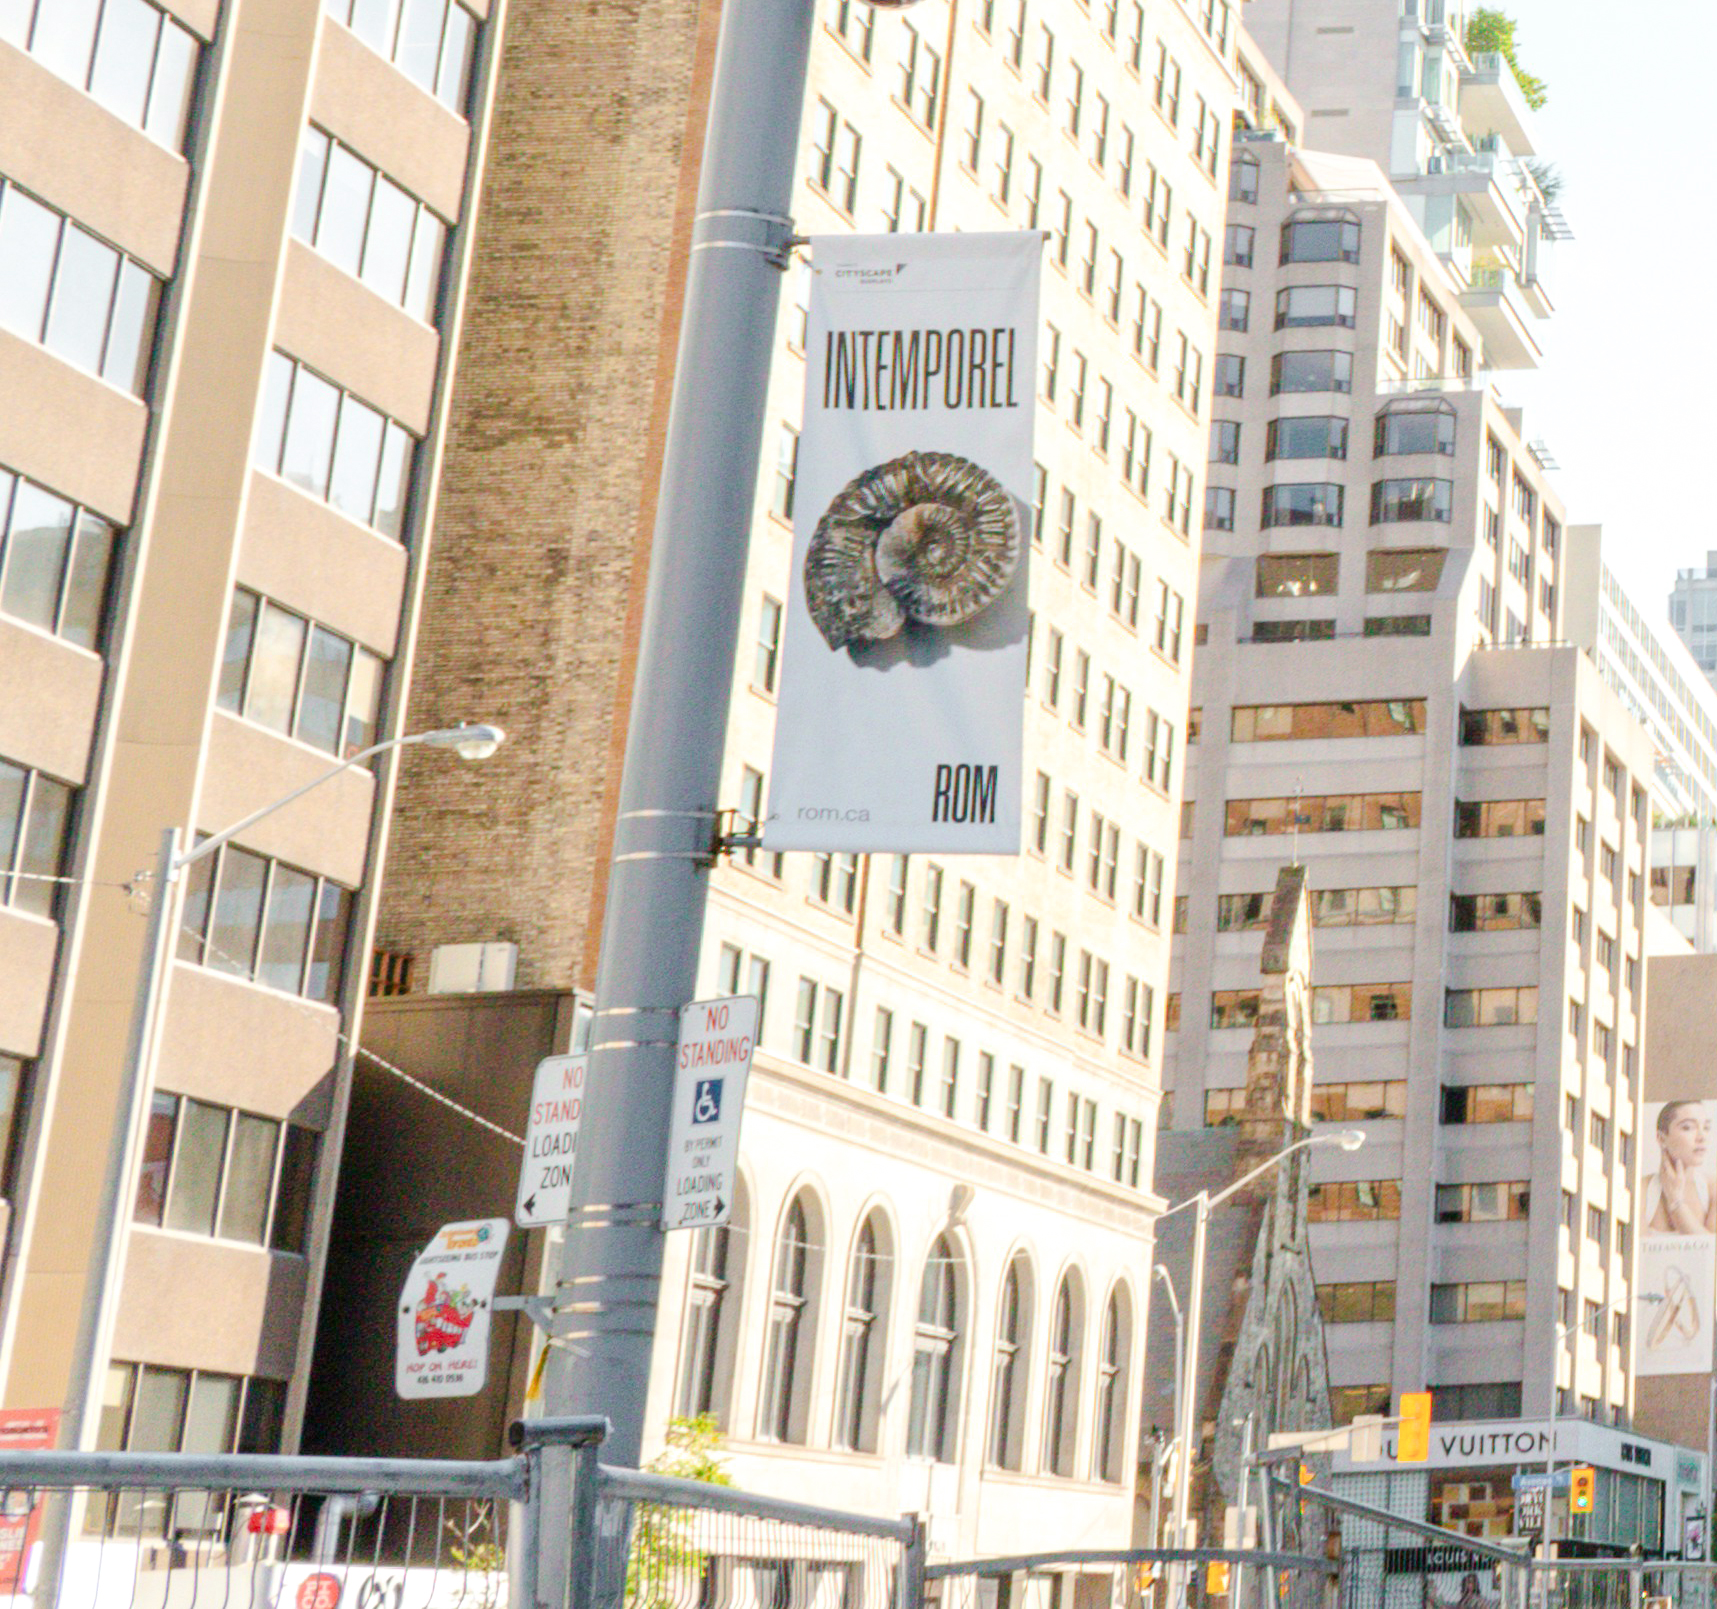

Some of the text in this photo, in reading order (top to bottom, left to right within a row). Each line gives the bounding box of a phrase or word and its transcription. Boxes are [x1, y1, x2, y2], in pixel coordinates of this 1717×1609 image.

[835, 269, 892, 278] CITYSCAPE
[823, 328, 1019, 411] INTEMPOREL
[932, 763, 998, 823] ROM
[797, 806, 870, 822] rom.ca
[706, 1005, 728, 1032] NO
[680, 1036, 750, 1070] STANDING
[563, 1066, 583, 1090] NO
[533, 1098, 581, 1126] STAND
[532, 1132, 577, 1158] LOADI
[684, 1135, 722, 1153] BY PERMIT
[692, 1155, 710, 1169] ONLY
[540, 1164, 572, 1189] ZON
[677, 1173, 722, 1196] LOADING
[682, 1200, 711, 1222] ZONE
[464, 1252, 478, 1262] BUS
[480, 1250, 500, 1260] STOP
[1440, 1430, 1557, 1457] VUITTON
